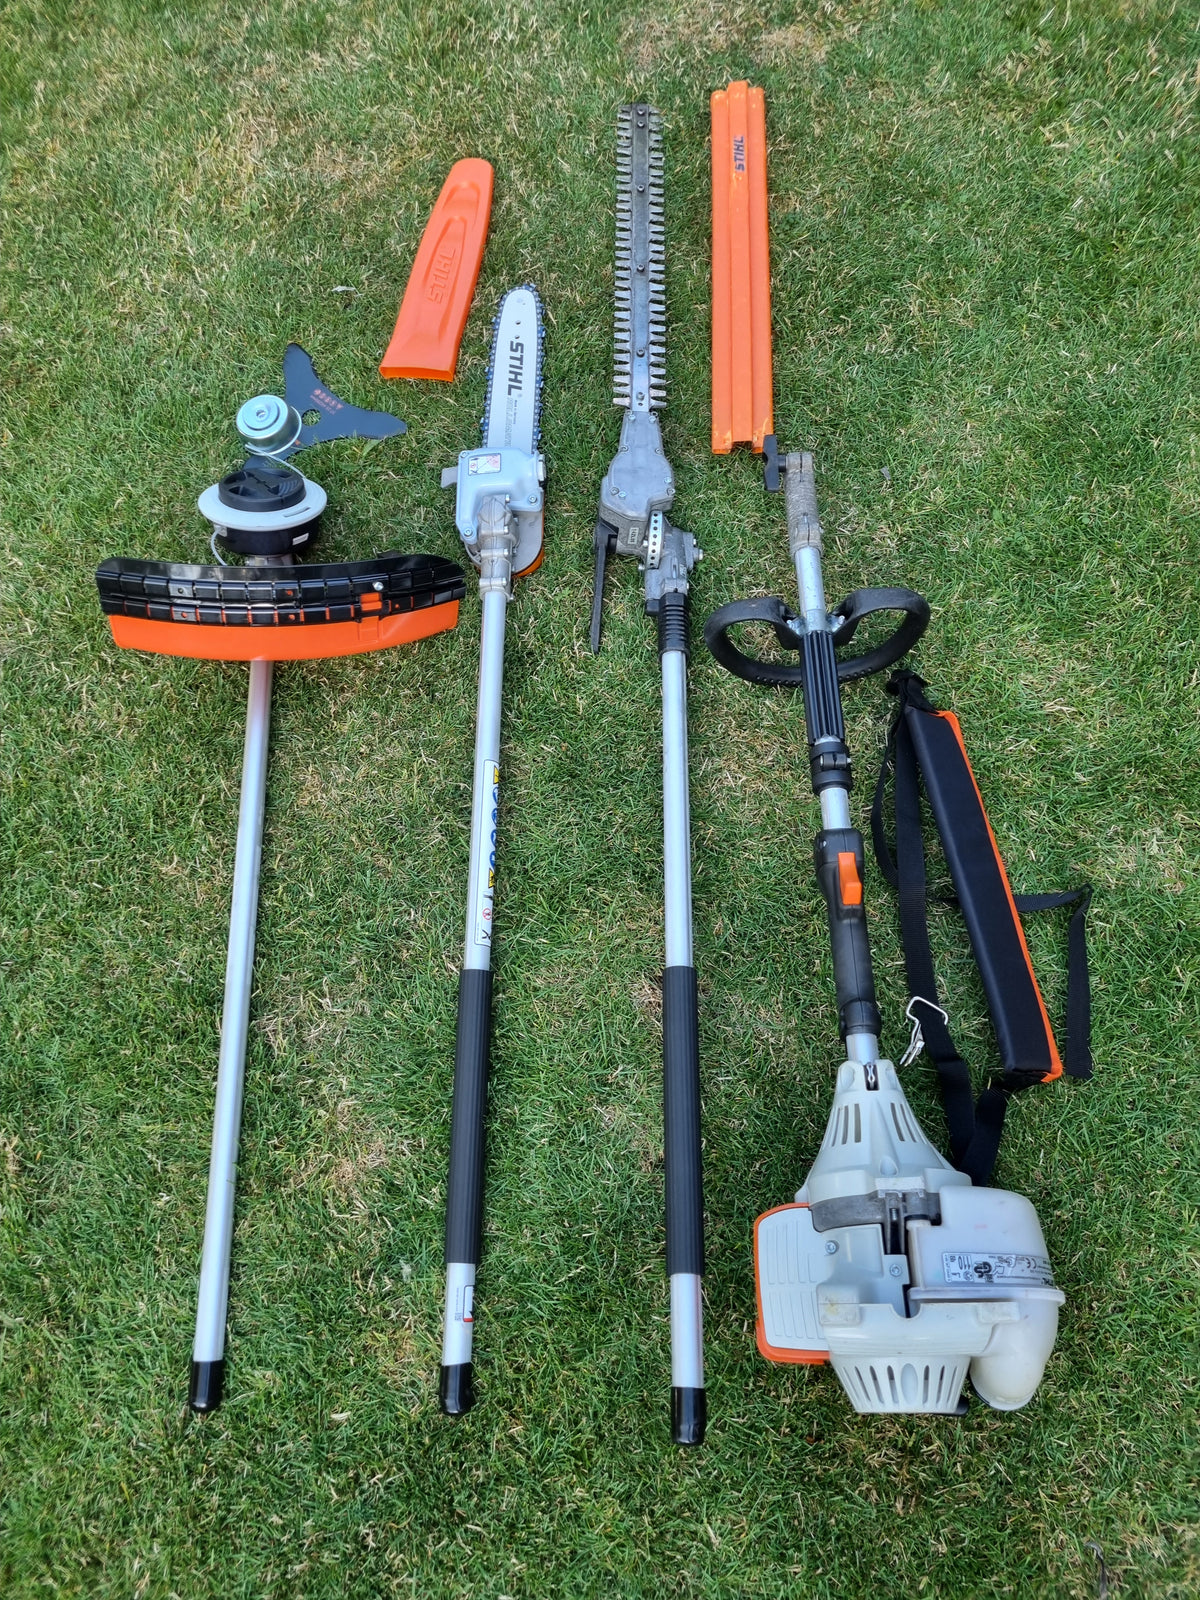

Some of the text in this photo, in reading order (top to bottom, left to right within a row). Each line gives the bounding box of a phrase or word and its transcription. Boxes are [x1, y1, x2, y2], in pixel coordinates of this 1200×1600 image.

[733, 136, 745, 172] STIHL
[428, 247, 456, 304] STIHL
[507, 341, 525, 396] STIHL
